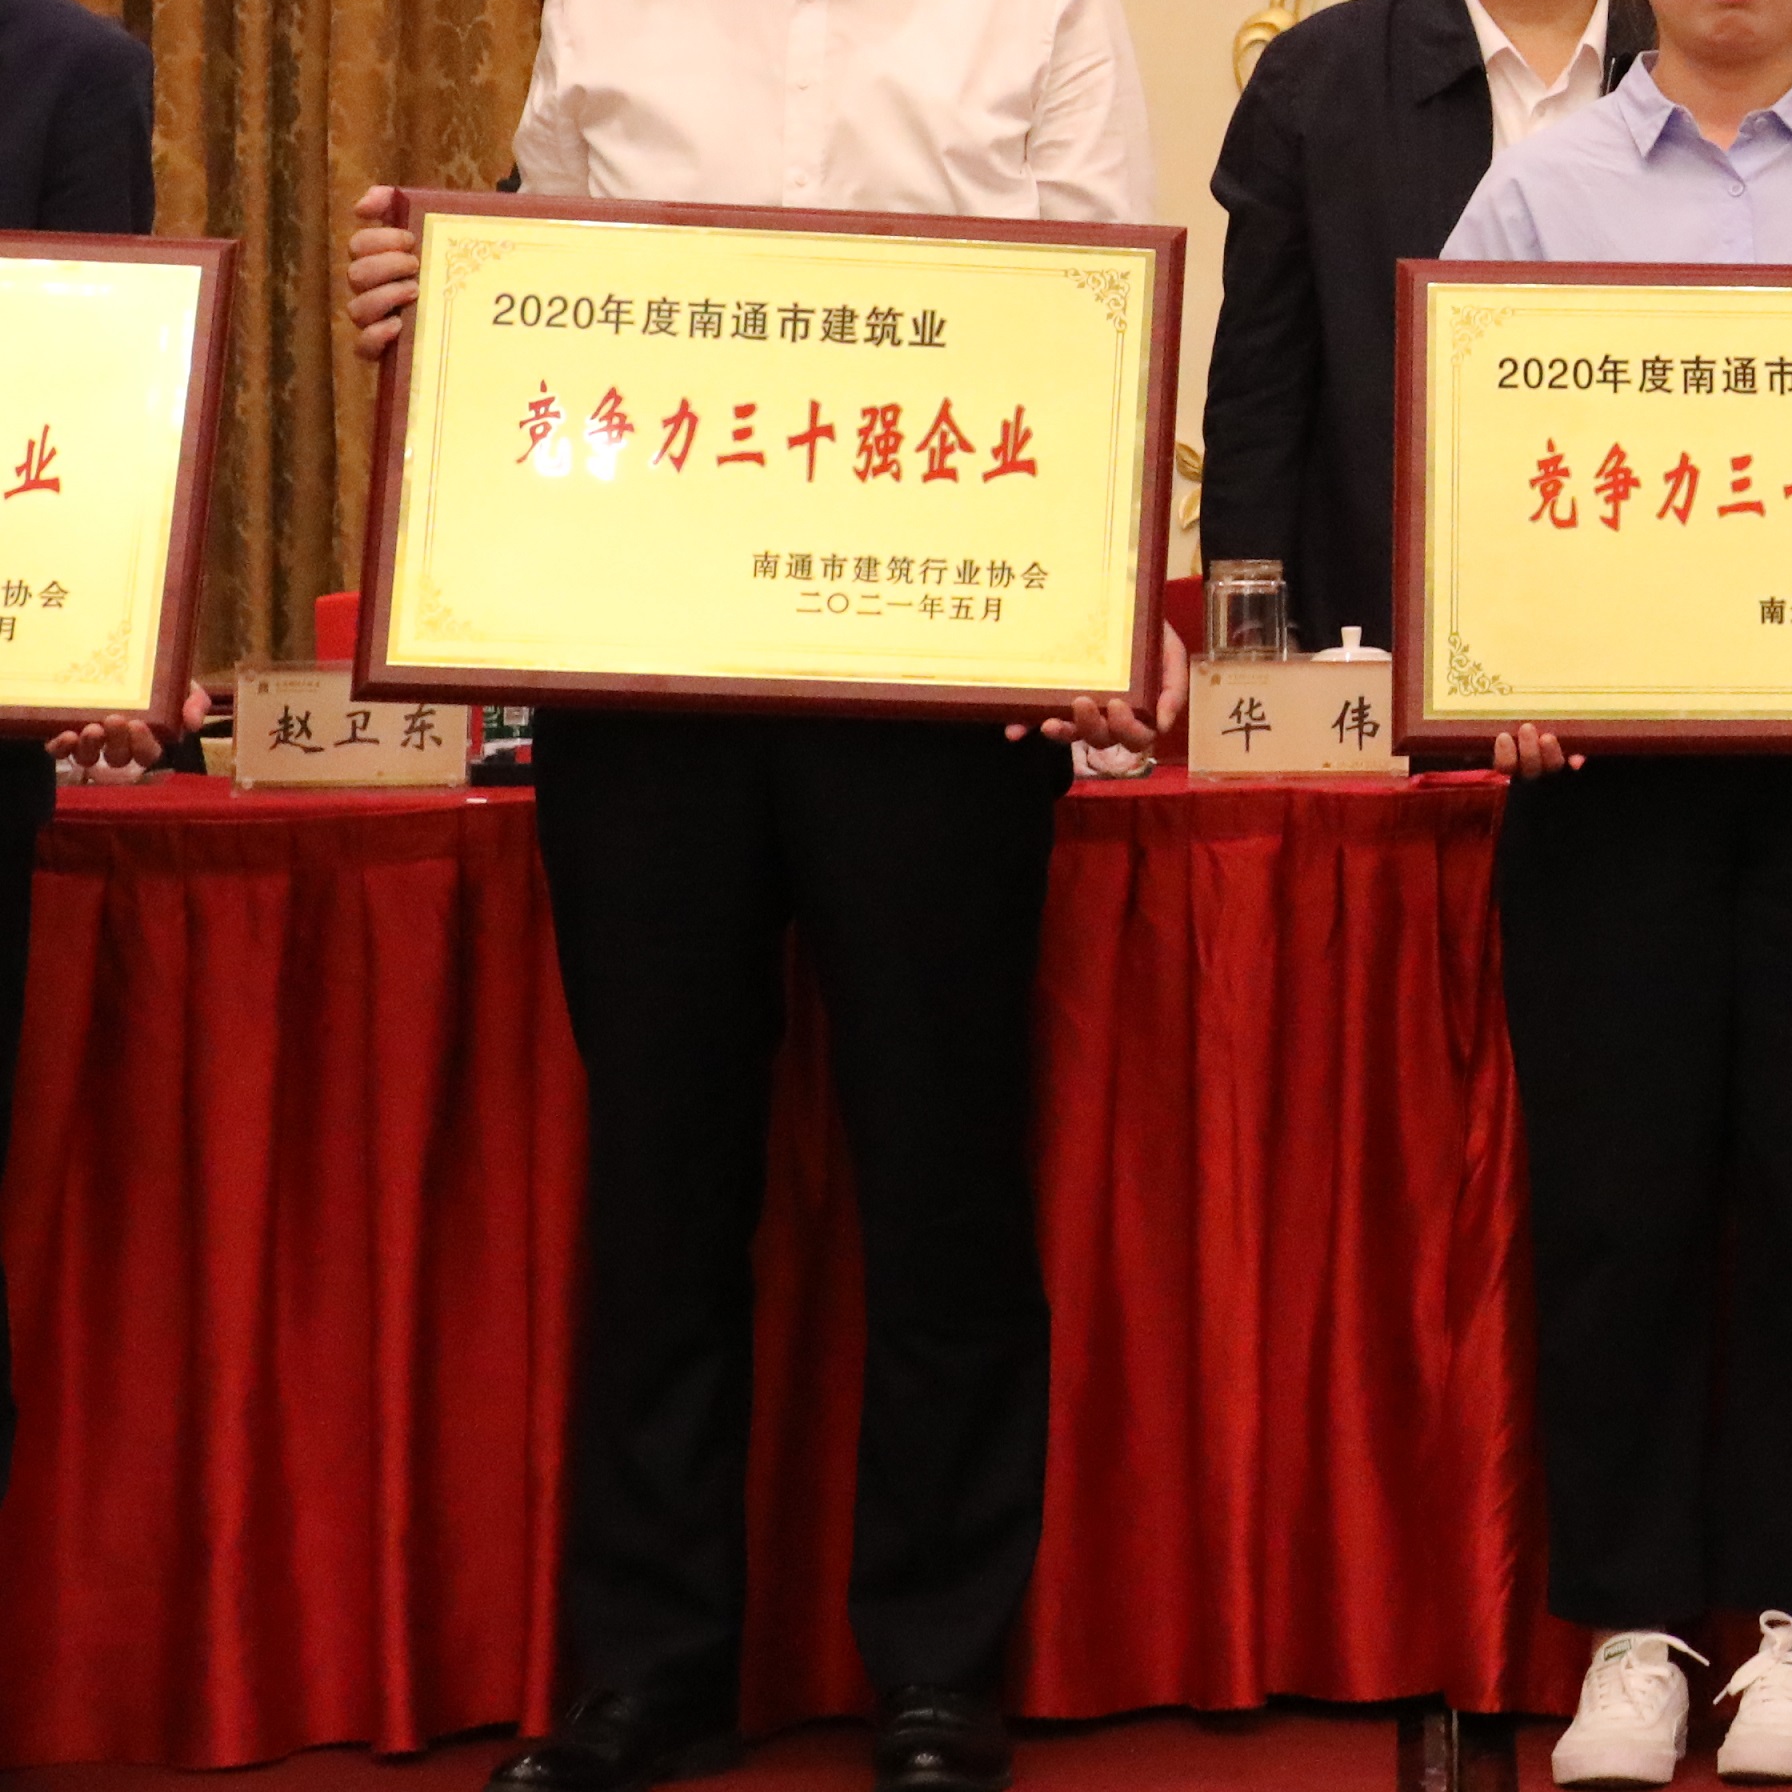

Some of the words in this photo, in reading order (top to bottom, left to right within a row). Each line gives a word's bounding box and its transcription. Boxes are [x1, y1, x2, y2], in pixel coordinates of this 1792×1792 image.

[493, 293, 946, 348] 2020年度南通市建筑业
[754, 552, 1047, 590] 南通市建筑行业协会
[268, 704, 443, 754] 赵卫东
[1222, 696, 1380, 752] 华伟
